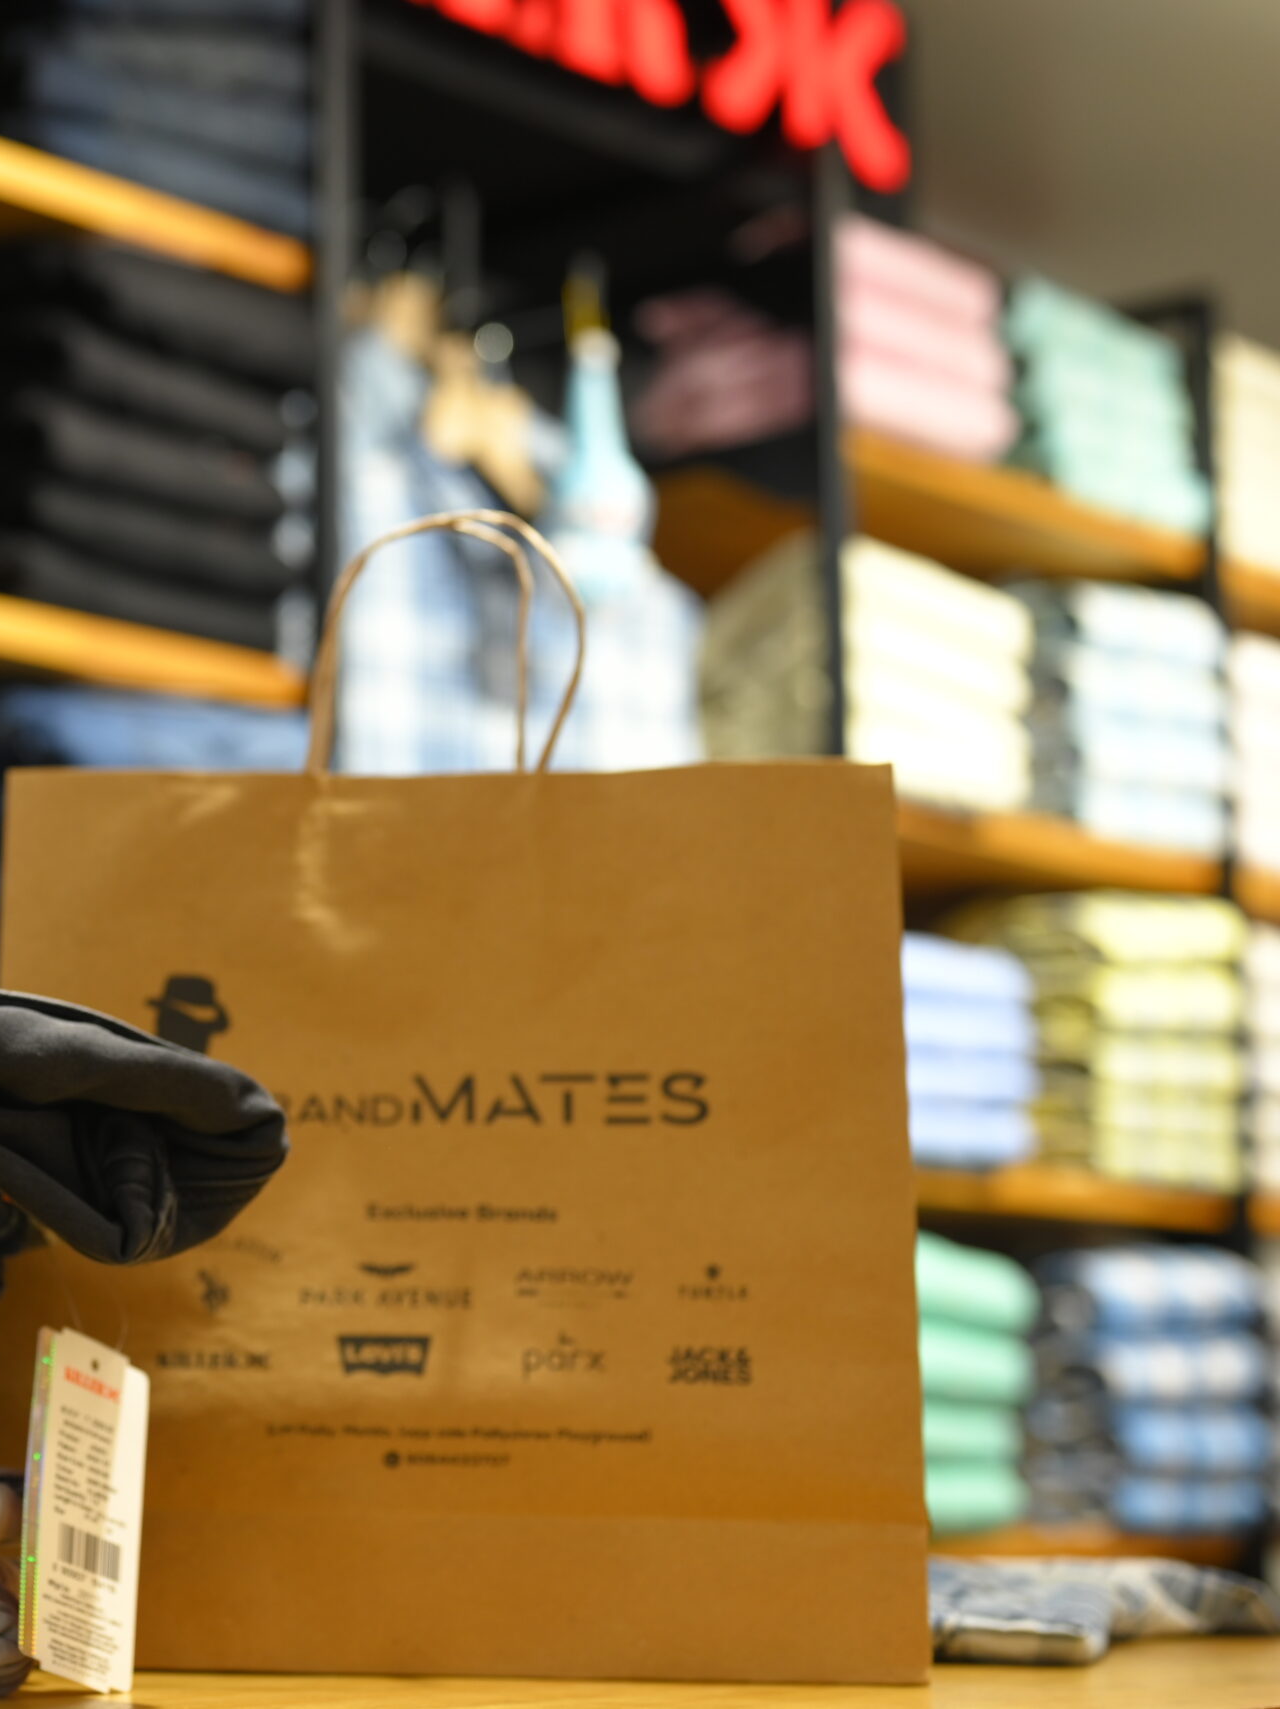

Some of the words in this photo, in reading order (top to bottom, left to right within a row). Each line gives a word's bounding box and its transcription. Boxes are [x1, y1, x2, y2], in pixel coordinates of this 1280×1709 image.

[366, 1203, 470, 1222] Exclusive
[476, 1204, 559, 1224] Brands
[515, 1267, 635, 1287] ARROW
[521, 1346, 608, 1382] parx
[667, 1365, 752, 1385] JONES
